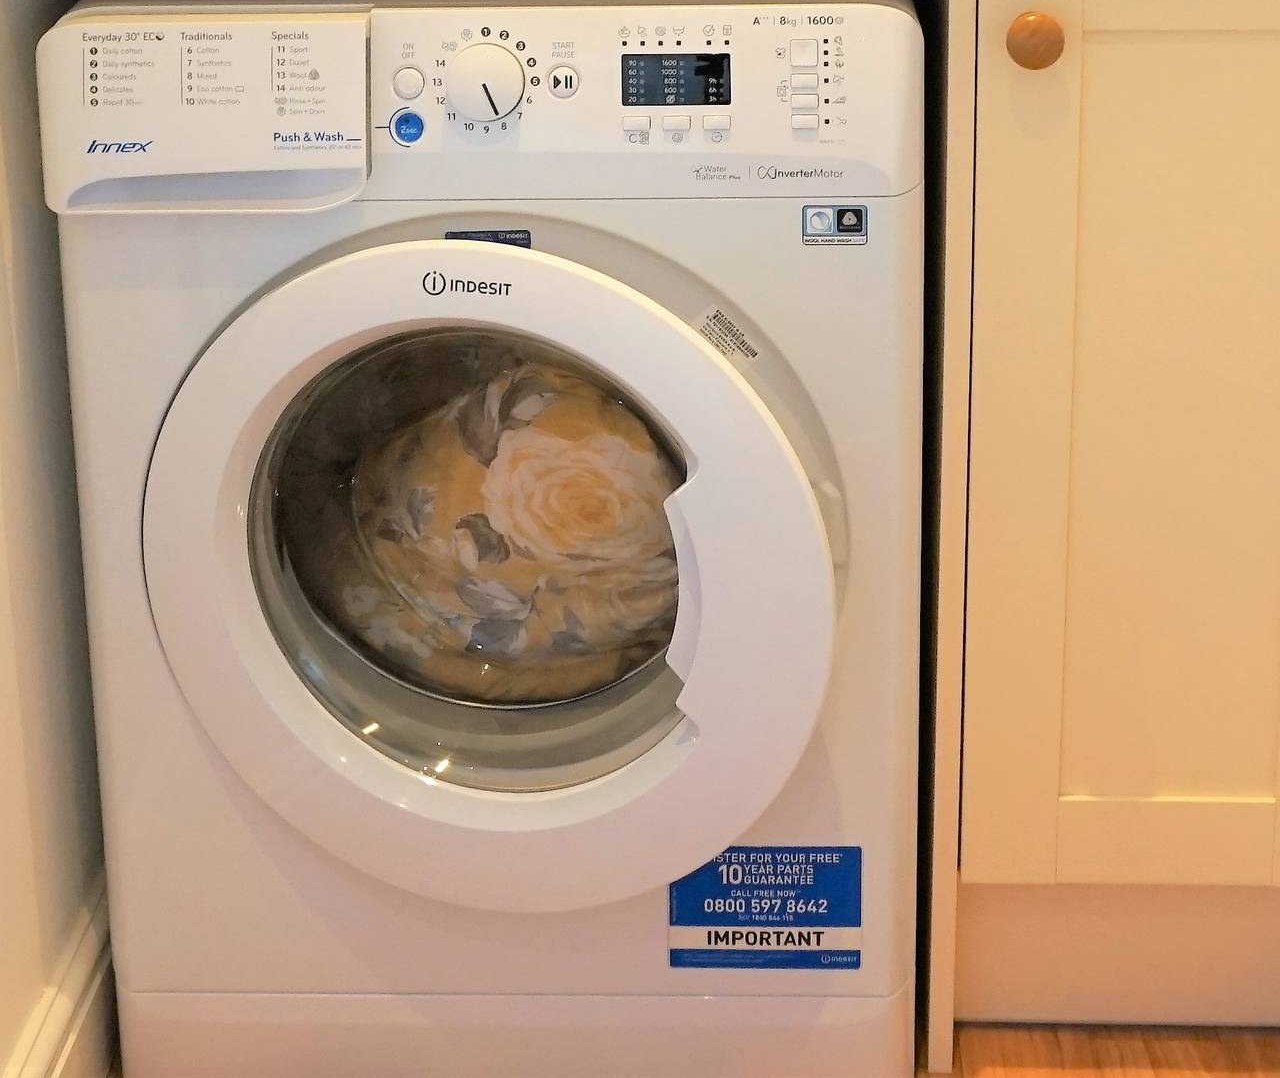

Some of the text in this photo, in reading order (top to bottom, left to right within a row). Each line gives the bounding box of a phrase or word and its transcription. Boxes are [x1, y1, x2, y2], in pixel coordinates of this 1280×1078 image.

[779, 16, 797, 27] 8kg
[807, 16, 834, 26] 1600
[82, 33, 122, 43] Everyday
[180, 32, 233, 41] Traditionals
[271, 31, 309, 41] Specials
[277, 45, 285, 53] 11
[436, 59, 446, 67] 14
[187, 72, 193, 80] 8
[185, 98, 195, 106] 10
[527, 96, 532, 104] 6
[518, 112, 523, 120] 7
[464, 123, 474, 131] 10
[484, 126, 489, 134] 9
[274, 132, 344, 142] Push & Wash
[87, 140, 153, 153] Innex
[704, 165, 727, 173] Water
[751, 854, 771, 863] FOR
[776, 854, 805, 863] YOUR
[719, 864, 814, 884] 10 YEAR PARTS
[744, 876, 814, 884] GUARANTEE
[704, 899, 828, 913] 0800 597 8642
[707, 930, 825, 947] IMPORTANT
